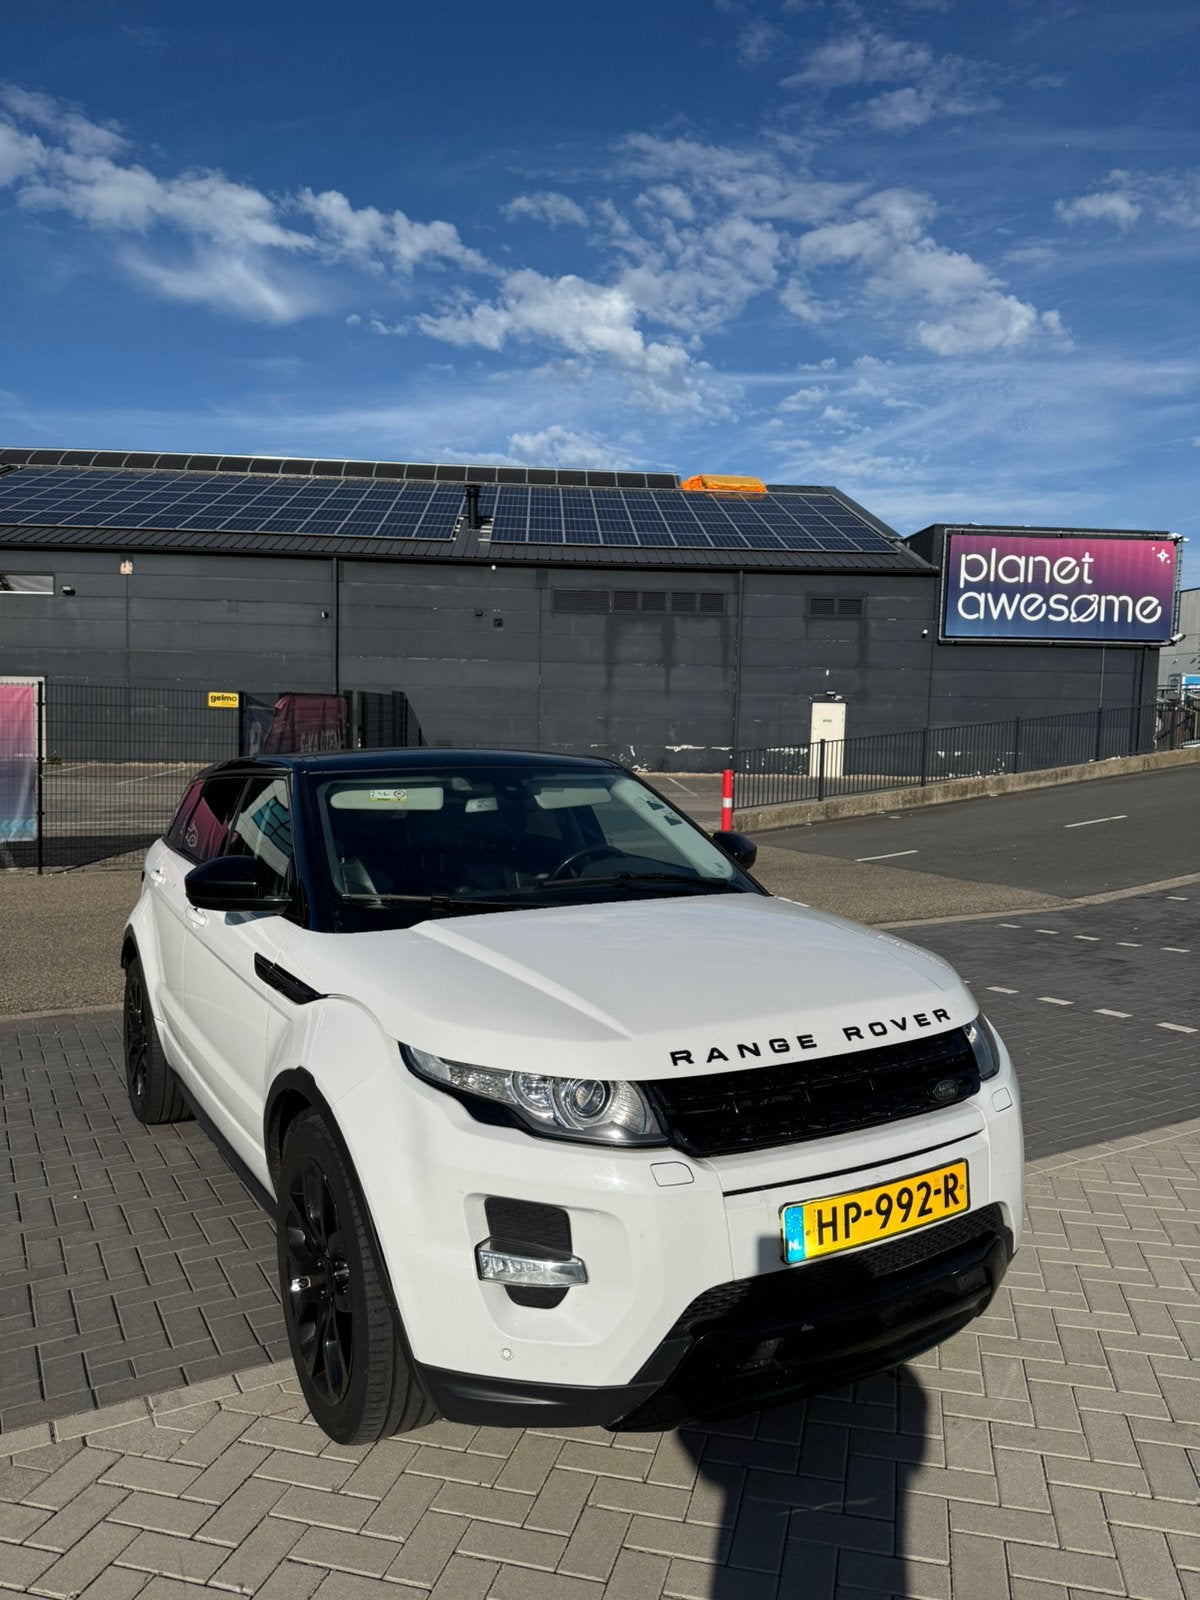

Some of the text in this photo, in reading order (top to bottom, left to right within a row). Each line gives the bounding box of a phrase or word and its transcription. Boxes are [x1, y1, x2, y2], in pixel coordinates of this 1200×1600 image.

[959, 547, 1095, 589] planet
[210, 693, 238, 703] gelmo
[669, 1007, 952, 1067] RANGE ROVER
[816, 1172, 960, 1246] HP-992-R
[787, 1239, 802, 1252] NL
